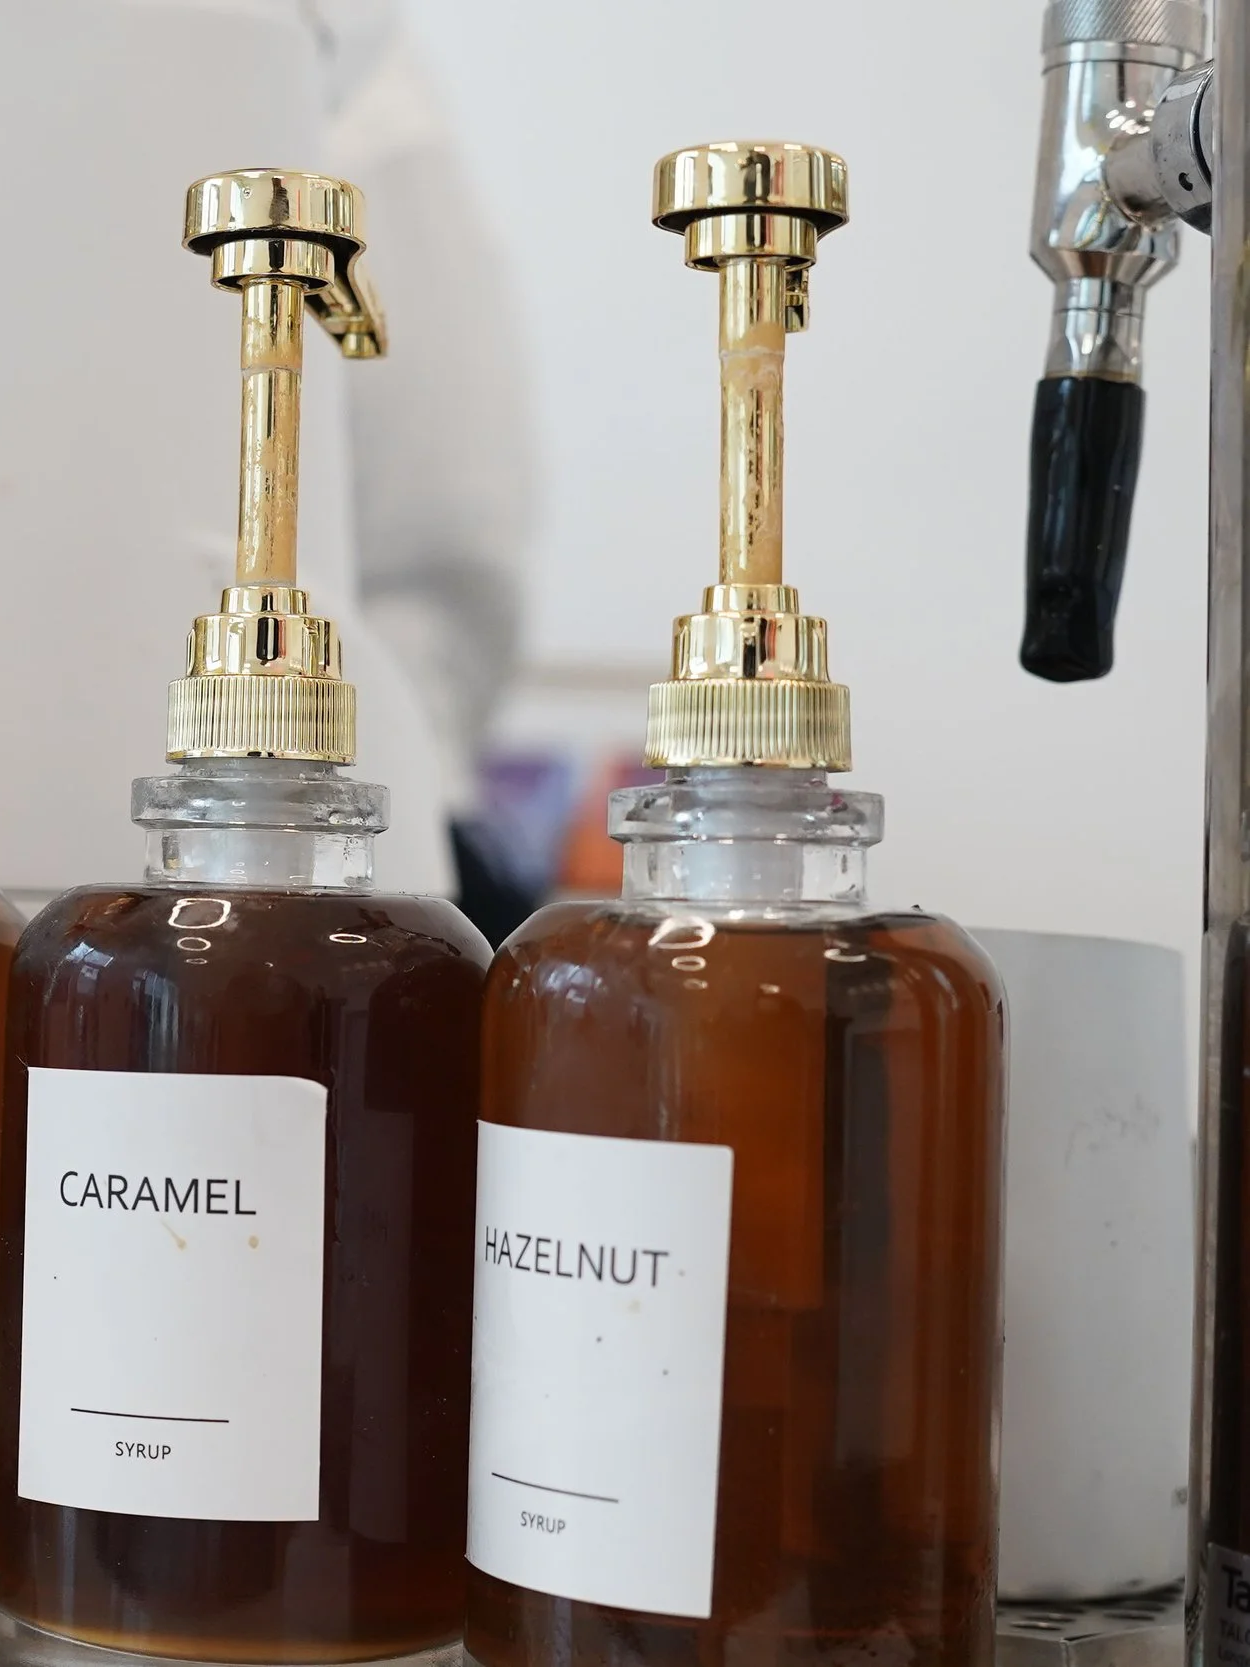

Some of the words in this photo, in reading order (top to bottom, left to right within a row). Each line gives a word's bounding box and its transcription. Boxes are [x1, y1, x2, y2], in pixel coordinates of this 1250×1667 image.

[59, 1170, 257, 1216] CARAMEL
[484, 1225, 670, 1288] HAZELNUT
[115, 1440, 172, 1461] SYRUP
[520, 1510, 566, 1534] SYRUP
